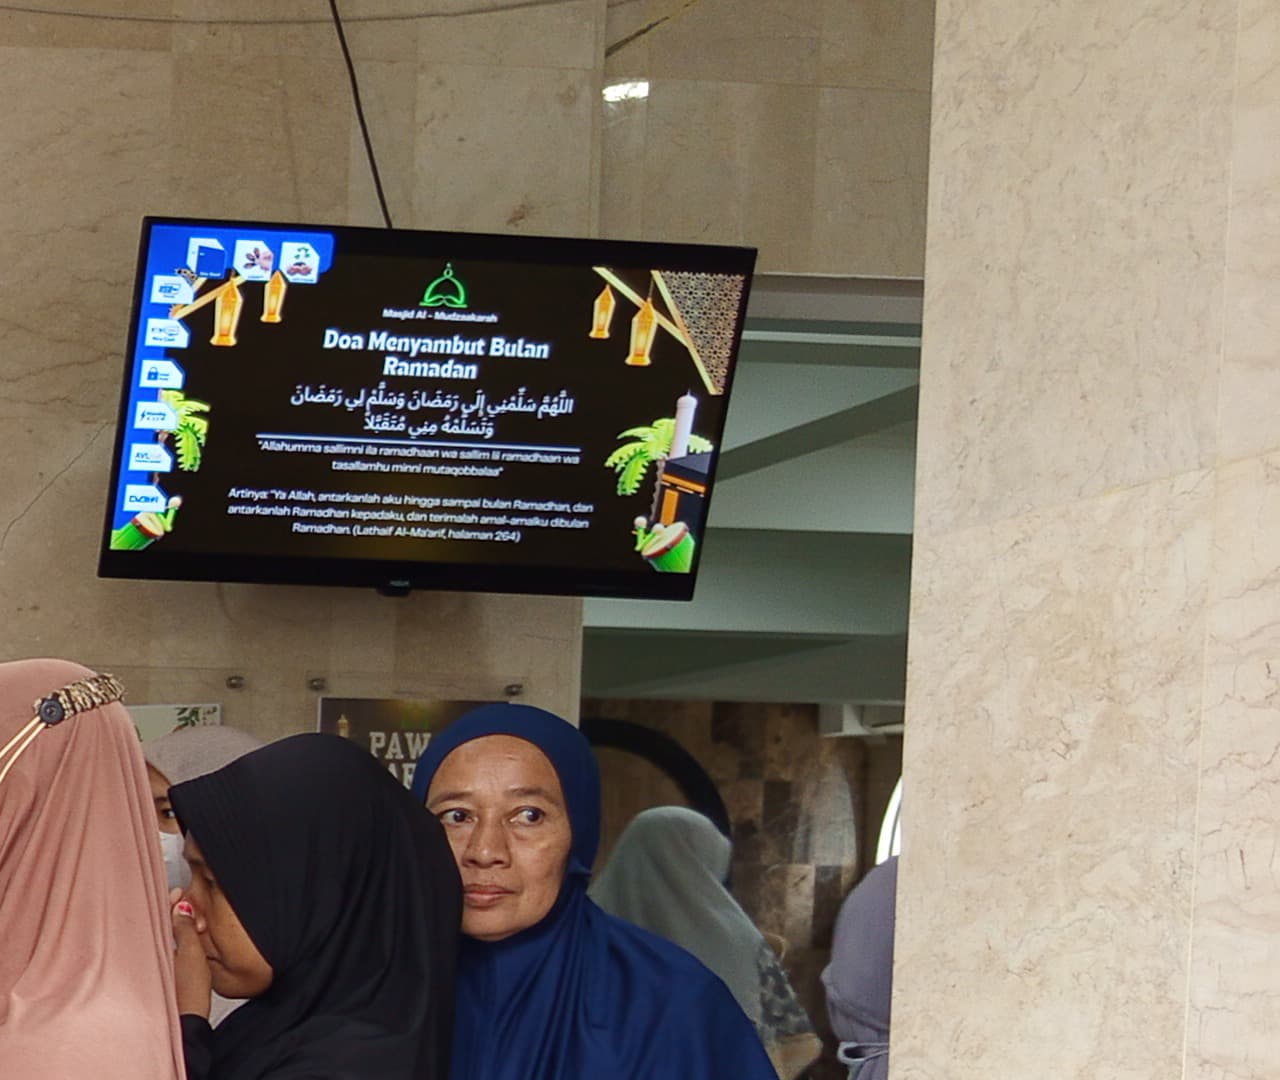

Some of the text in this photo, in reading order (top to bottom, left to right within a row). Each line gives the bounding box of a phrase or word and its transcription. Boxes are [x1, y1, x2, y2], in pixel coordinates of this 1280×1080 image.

[382, 308, 415, 321] Masjid
[416, 310, 427, 320] Al
[323, 329, 550, 359] Doa Menyambut Bulan
[383, 356, 478, 379] Ramadan
[392, 463, 422, 473] minni
[441, 449, 458, 458] wa
[563, 455, 580, 464] wa
[288, 490, 316, 502] Allah,
[318, 492, 381, 504] antarkanlah
[382, 494, 402, 504] aku
[404, 495, 441, 508] hingga
[442, 498, 481, 509] sampai
[482, 498, 512, 509] bulan
[573, 503, 594, 513] dan
[228, 504, 291, 516] antarkanlah
[292, 506, 350, 519] Ramadhan
[406, 511, 428, 521] dan
[550, 517, 590, 529] dibulan
[448, 528, 494, 541] halaman
[369, 731, 432, 760] PAW
